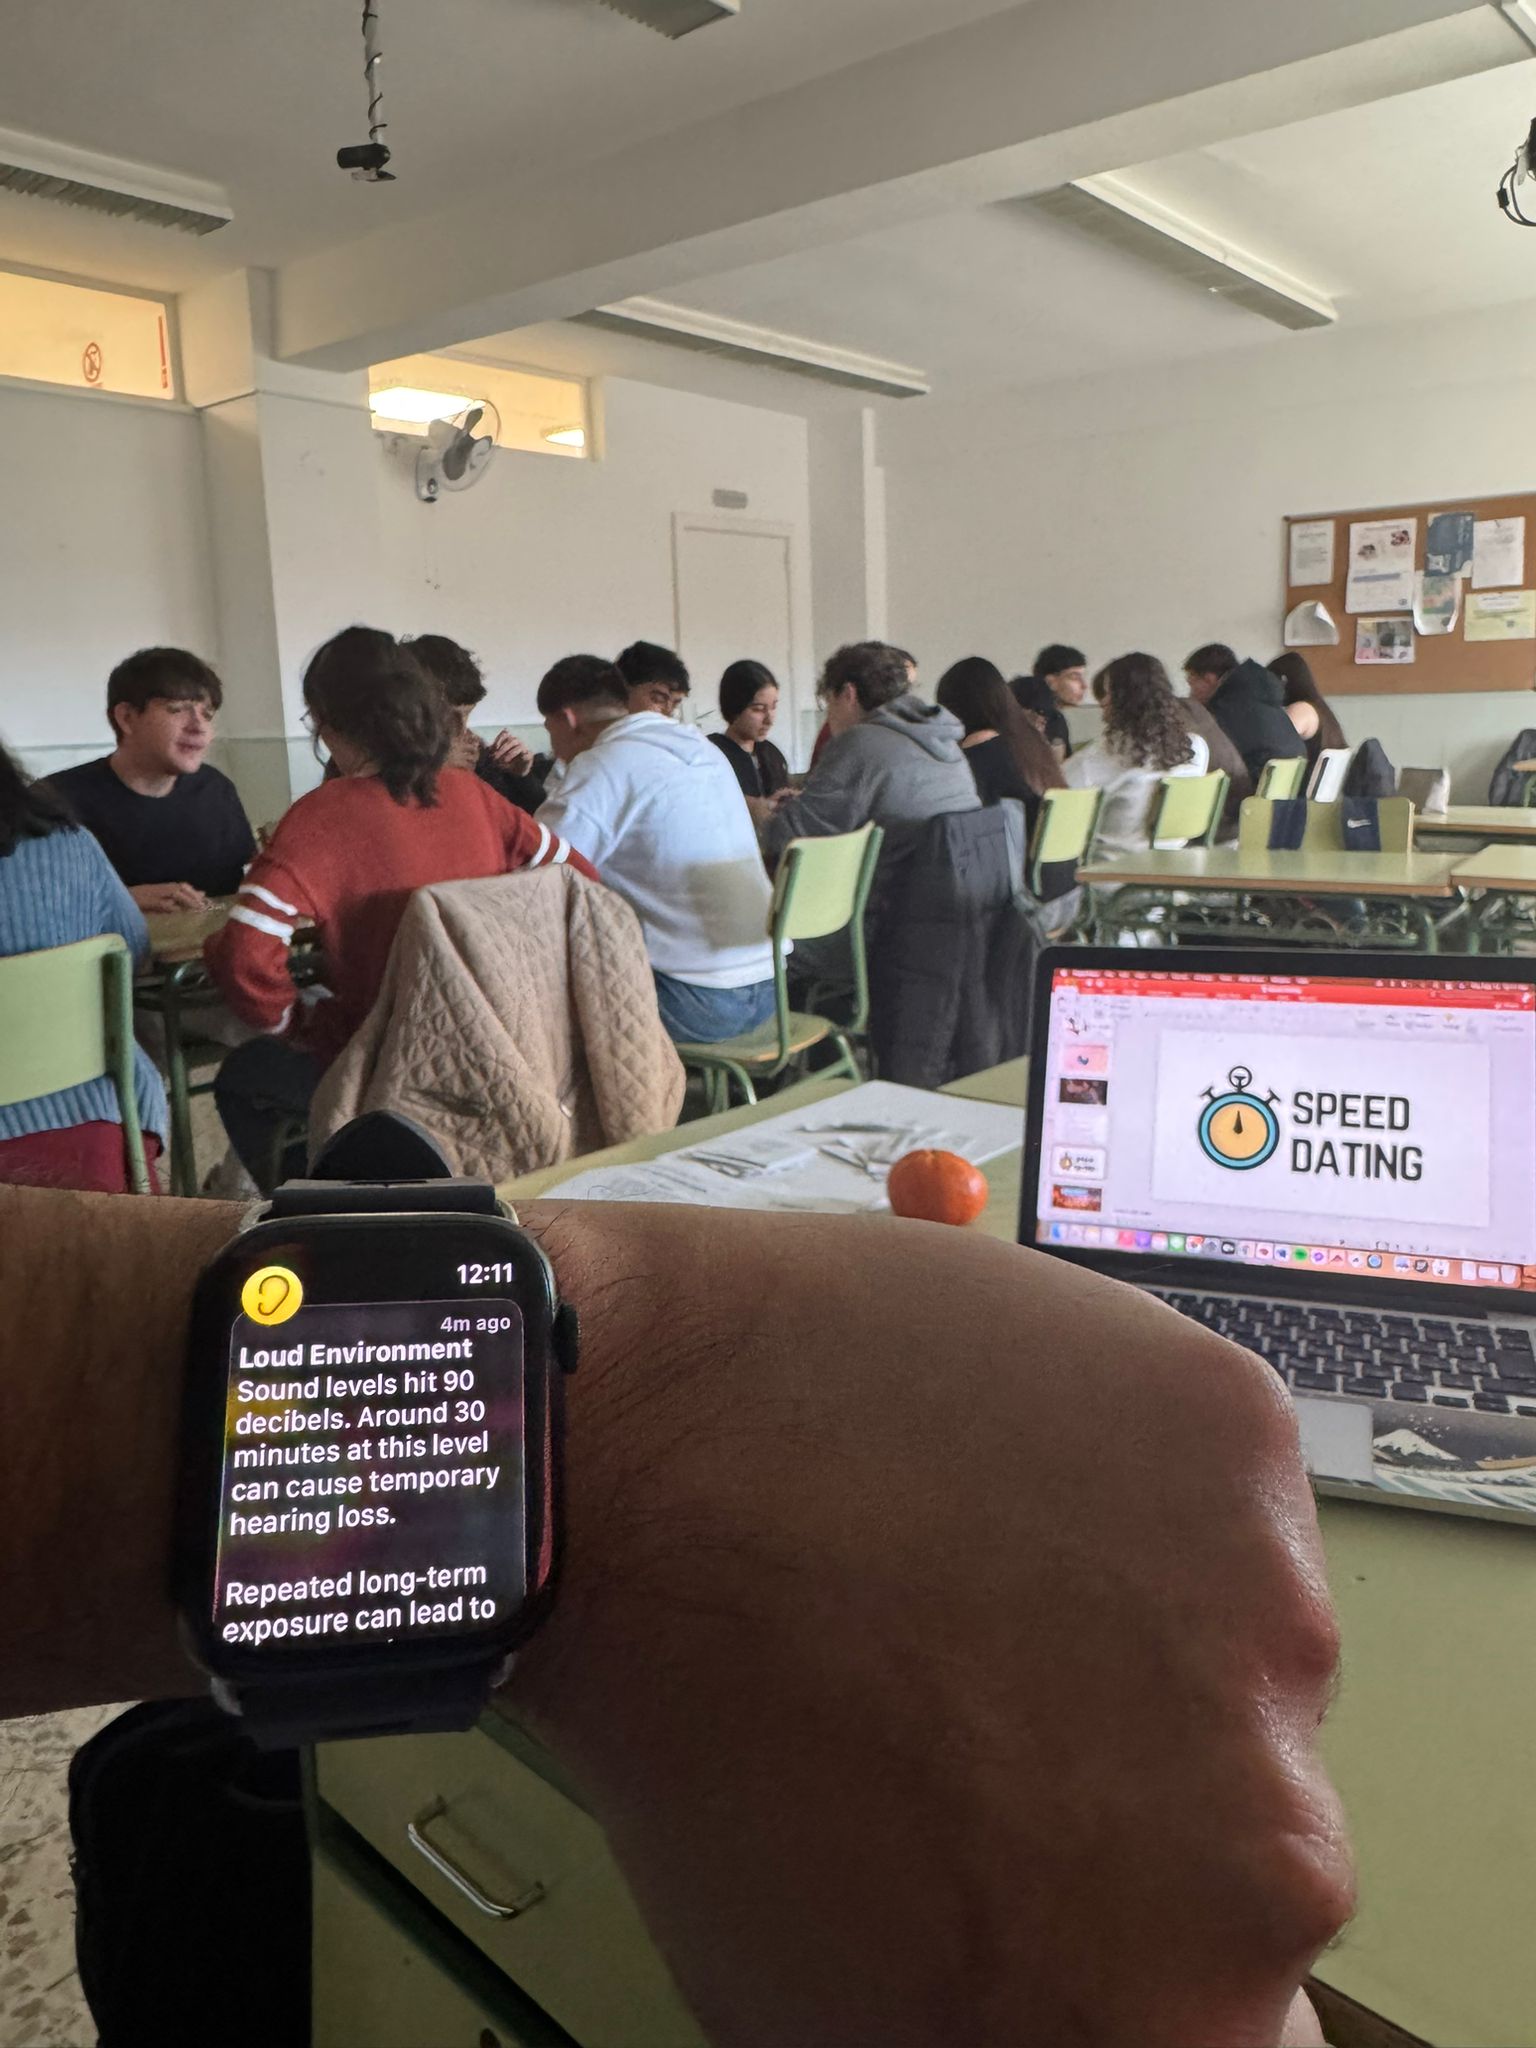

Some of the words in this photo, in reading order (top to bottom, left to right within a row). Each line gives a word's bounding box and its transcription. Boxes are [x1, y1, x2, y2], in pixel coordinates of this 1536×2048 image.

[1292, 1090, 1411, 1132] SPEED
[1291, 1137, 1424, 1182] DATING
[456, 1262, 513, 1285] 12:11
[440, 1316, 470, 1332] 4m
[476, 1317, 511, 1334] ago
[239, 1343, 304, 1369] Loud
[310, 1338, 473, 1366] Environment
[236, 1376, 319, 1403] Sound
[326, 1371, 398, 1398] levels
[404, 1370, 438, 1394] hit
[443, 1369, 475, 1392] 90
[235, 1406, 351, 1435] decibels.
[356, 1400, 448, 1429] Around
[454, 1399, 486, 1423] 30
[233, 1442, 340, 1469] minutes
[346, 1438, 373, 1461] at
[377, 1434, 427, 1459] this
[432, 1430, 489, 1456] level
[231, 1481, 279, 1502] can
[285, 1473, 363, 1498] cause
[368, 1465, 500, 1494] temporary
[229, 1506, 331, 1537] hearing
[337, 1504, 396, 1528] loss.
[225, 1571, 352, 1609] Repeated
[359, 1565, 487, 1596] long-term
[222, 1613, 349, 1646] exposure
[355, 1607, 402, 1631] can
[409, 1596, 463, 1626] lead
[468, 1596, 496, 1620] to
